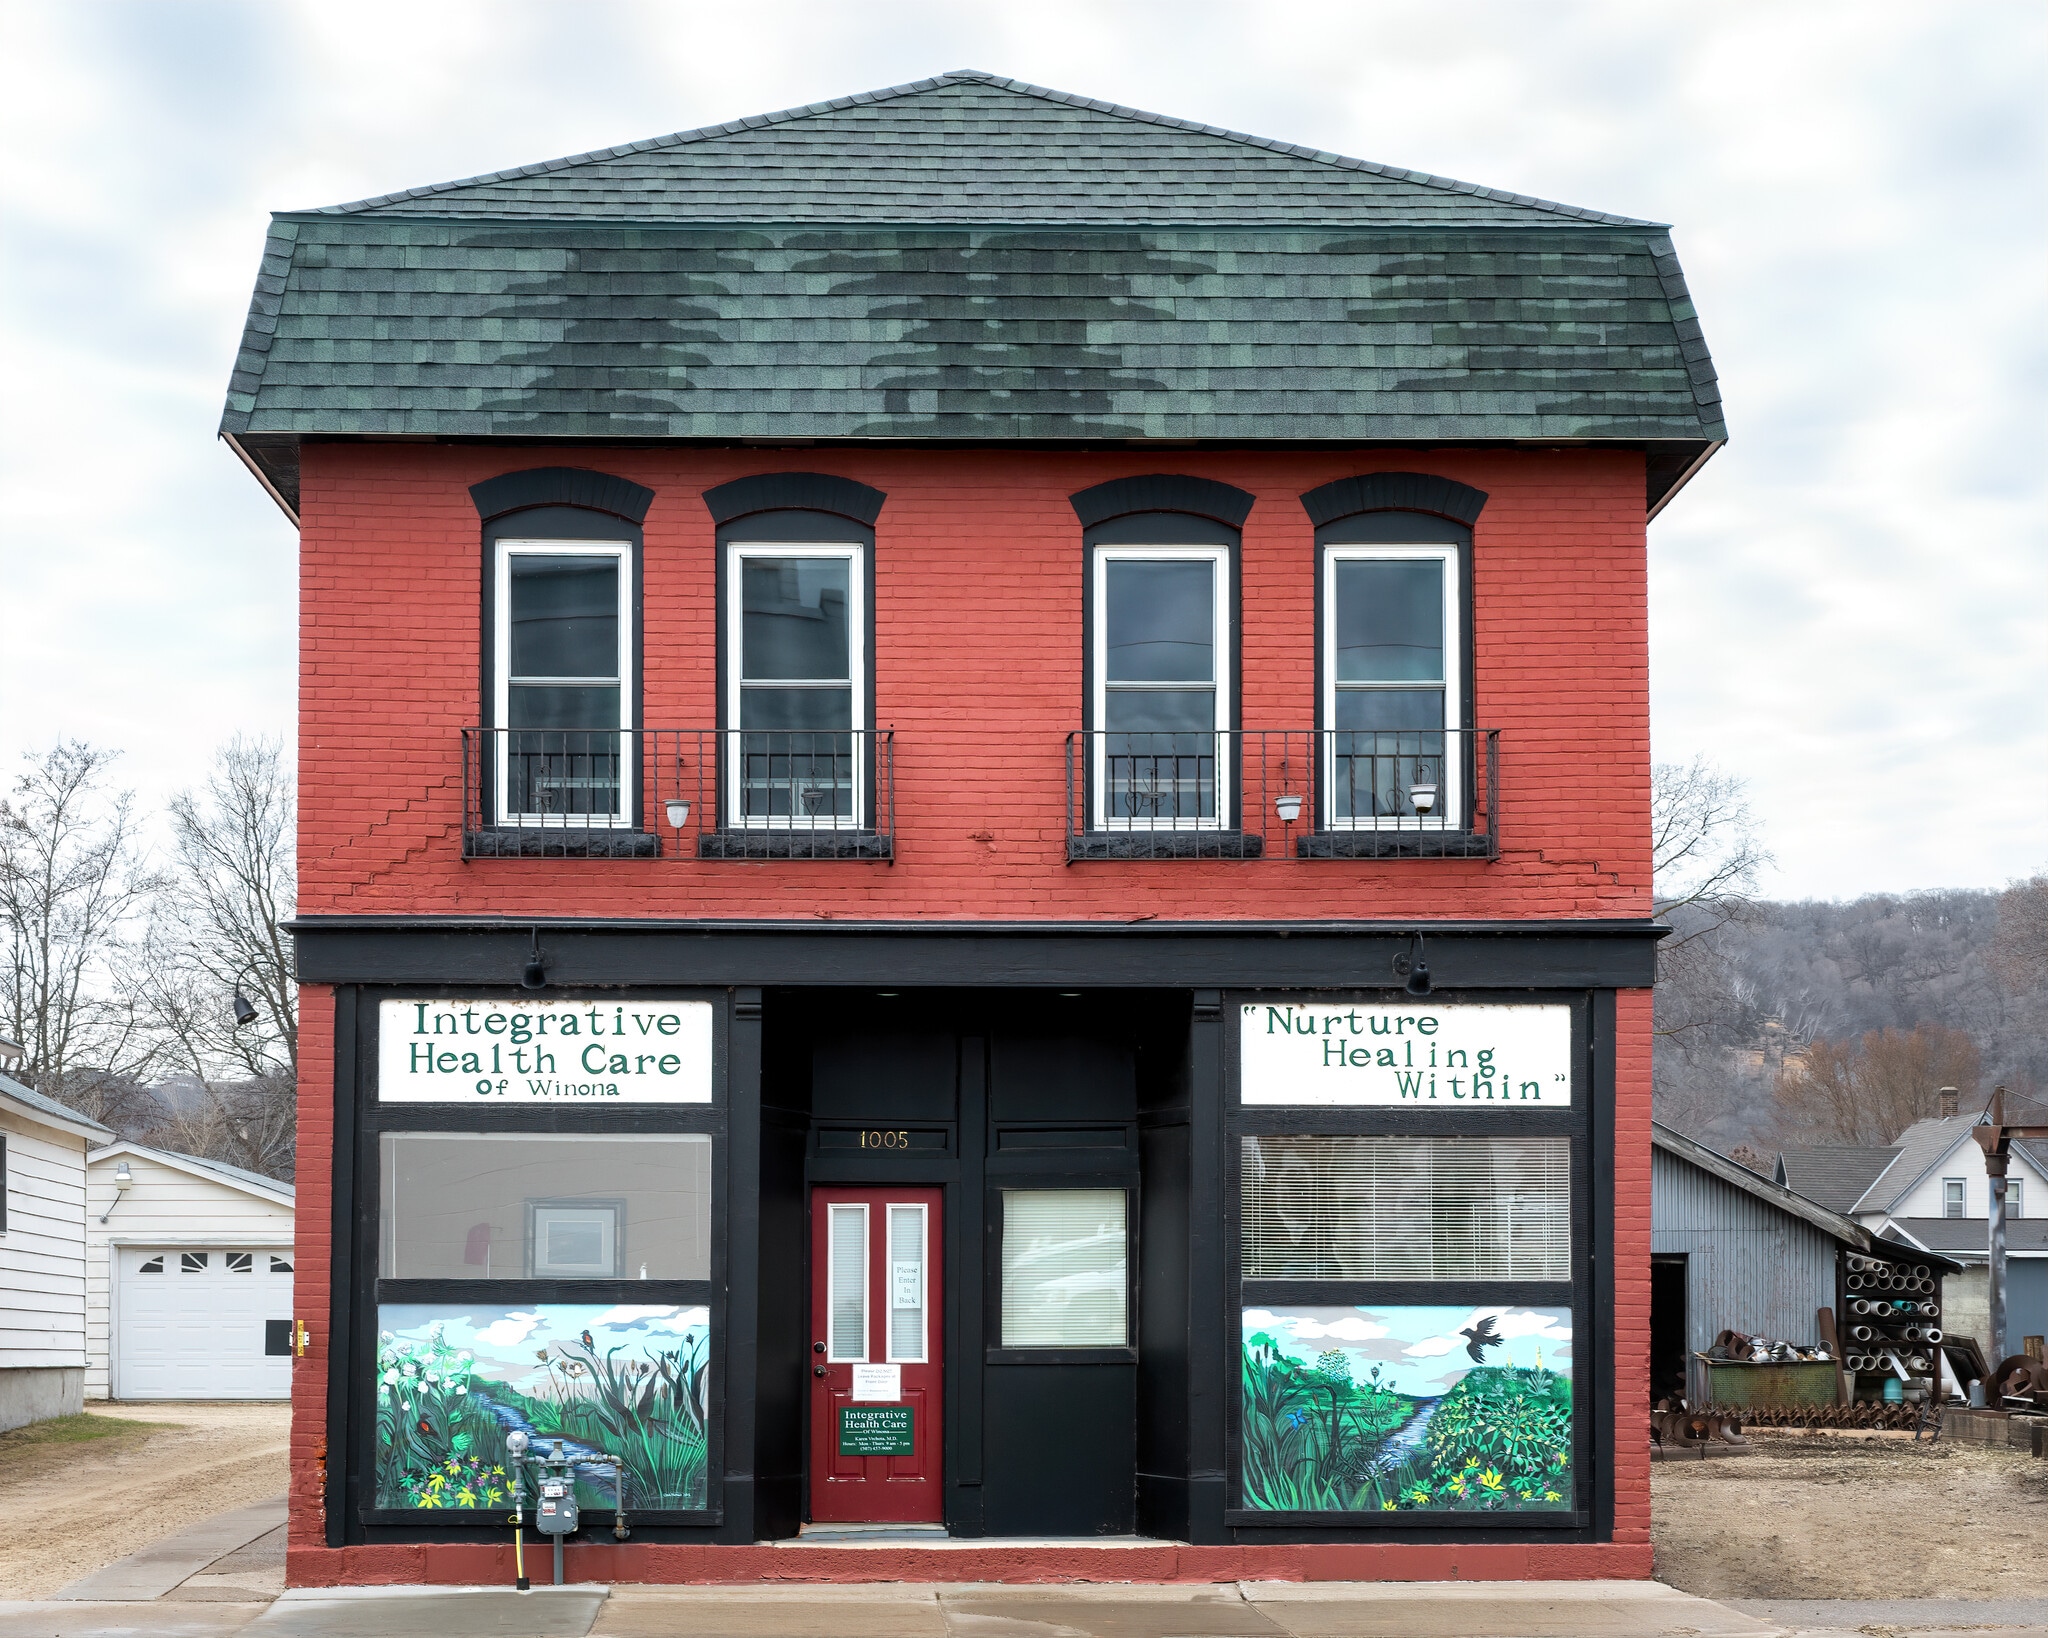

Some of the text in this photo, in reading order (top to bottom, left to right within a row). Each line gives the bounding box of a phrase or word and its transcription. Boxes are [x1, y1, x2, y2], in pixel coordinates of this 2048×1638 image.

[413, 1003, 681, 1045] Integrative
[409, 1042, 681, 1075] Health Care
[1323, 1039, 1495, 1079] Healing
[475, 1079, 620, 1096] of Winona
[860, 1130, 908, 1149] 1005
[896, 1266, 918, 1274] Please
[898, 1276, 916, 1284] Enter
[903, 1286, 911, 1294] In
[898, 1296, 916, 1304] Back
[845, 1410, 907, 1420] Integrative
[845, 1420, 907, 1428] Health Care
